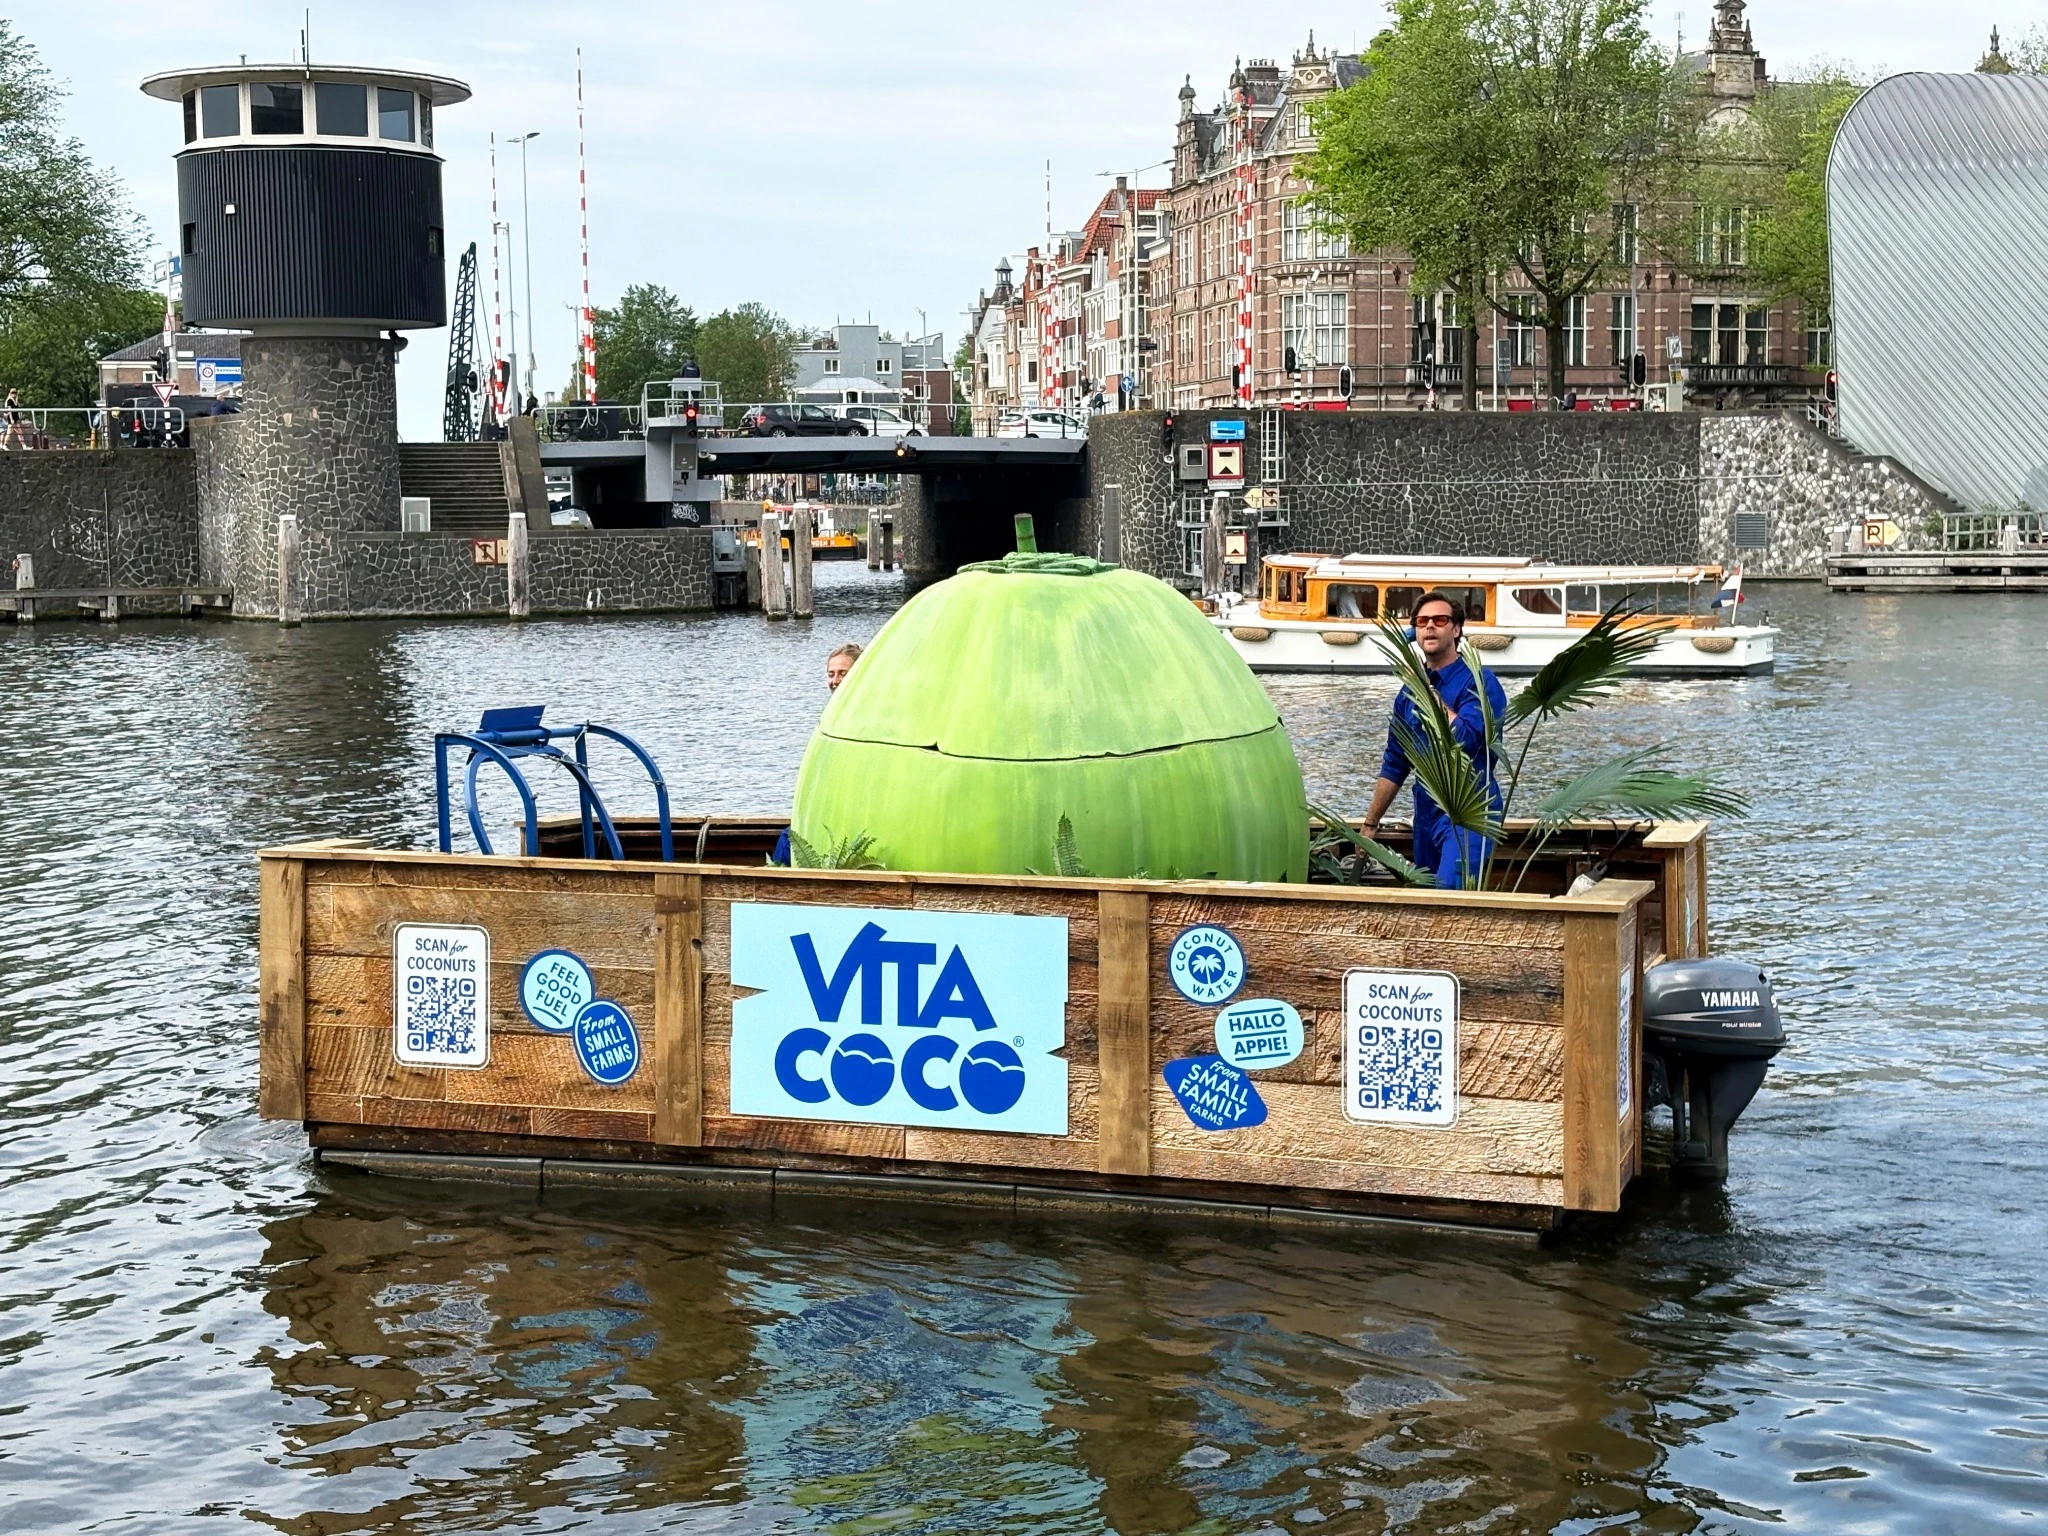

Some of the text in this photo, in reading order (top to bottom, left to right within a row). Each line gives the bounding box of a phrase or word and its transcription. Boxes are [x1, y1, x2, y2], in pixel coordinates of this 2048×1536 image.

[415, 937, 468, 956] SCAN for
[1175, 932, 1233, 971] COCONUT
[407, 956, 476, 973] COCONUTS
[550, 961, 579, 988] FEEL
[789, 921, 998, 1032] VITA
[536, 973, 582, 1005] GOOD
[1192, 969, 1238, 998] WATER
[1368, 984, 1433, 1004] SCAN for
[535, 989, 568, 1017] FUEL
[1701, 990, 1760, 1007] YAMAHA
[580, 1014, 616, 1034] From
[1228, 1013, 1286, 1032] HALLO
[1358, 1004, 1443, 1023] COCONUTS
[585, 1025, 627, 1053] SMALL
[1234, 1036, 1288, 1055] APPIE!
[591, 1044, 633, 1073] FARMS
[774, 1027, 1026, 1115] COCO
[1209, 1060, 1241, 1082] From
[1188, 1064, 1249, 1106] SMALL
[1177, 1080, 1248, 1123] FAMILY
[1189, 1104, 1224, 1127] FARMS
